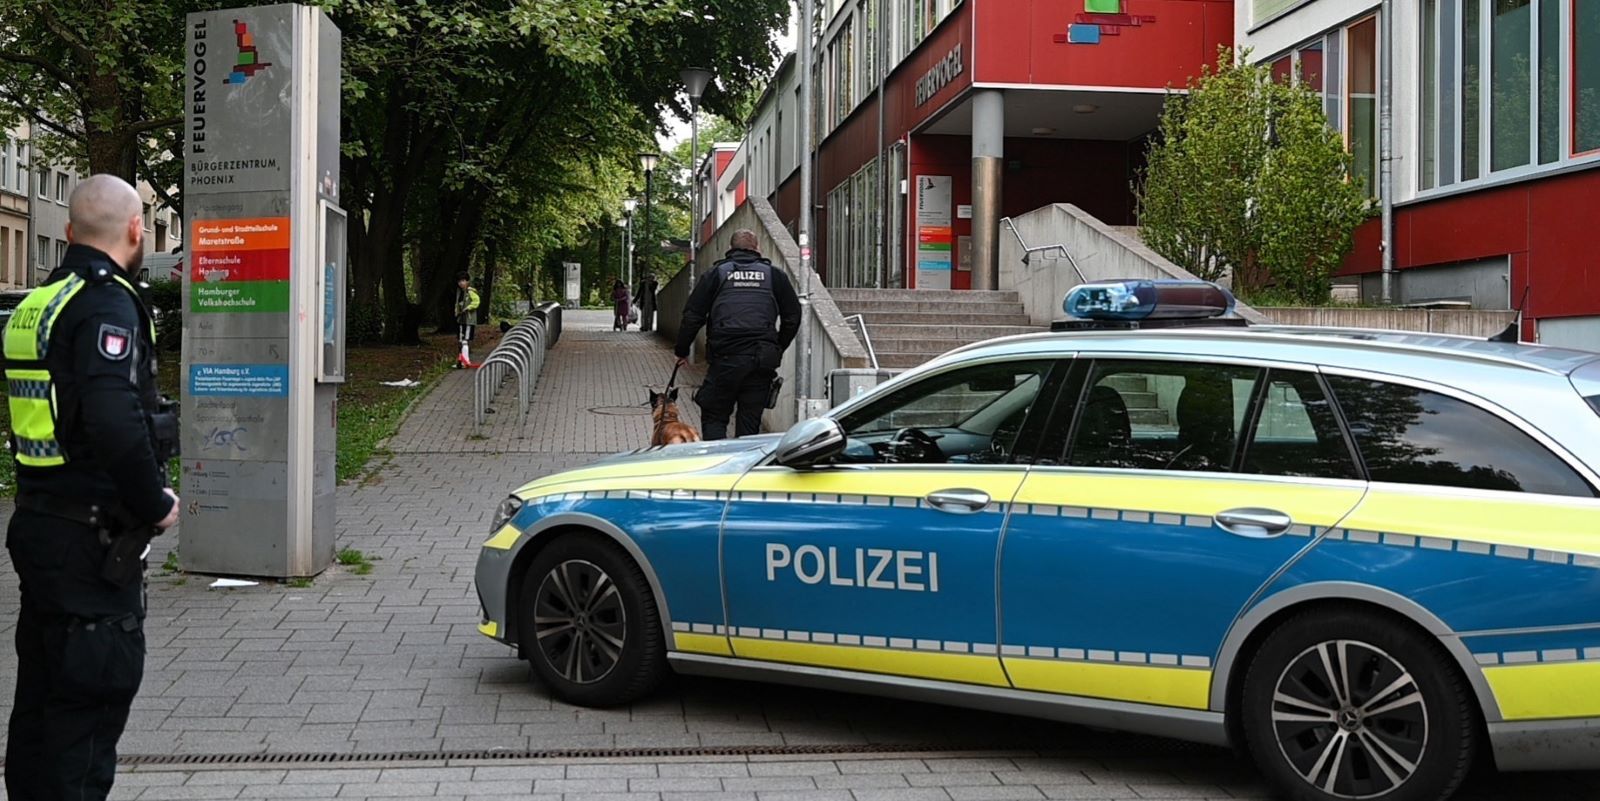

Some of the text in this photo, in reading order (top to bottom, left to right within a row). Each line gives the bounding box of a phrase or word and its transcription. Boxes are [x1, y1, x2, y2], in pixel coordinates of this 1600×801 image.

[914, 43, 963, 108] FEUERVOGEL
[193, 18, 207, 154] FEUERVOGEL
[191, 159, 277, 172] BÜRGERZENTRUM
[191, 175, 235, 185] PHOENIX
[199, 225, 220, 233] Grund-
[235, 224, 278, 233] Stadtteilschule
[199, 236, 245, 246] Maretstraße
[199, 255, 241, 265] Elternschule
[726, 271, 765, 280] POLIZEI
[198, 286, 240, 297] Hamburger
[198, 297, 256, 306] Volkshochschule
[214, 367, 240, 376] Hamburg
[766, 543, 939, 592] POLIZEI
